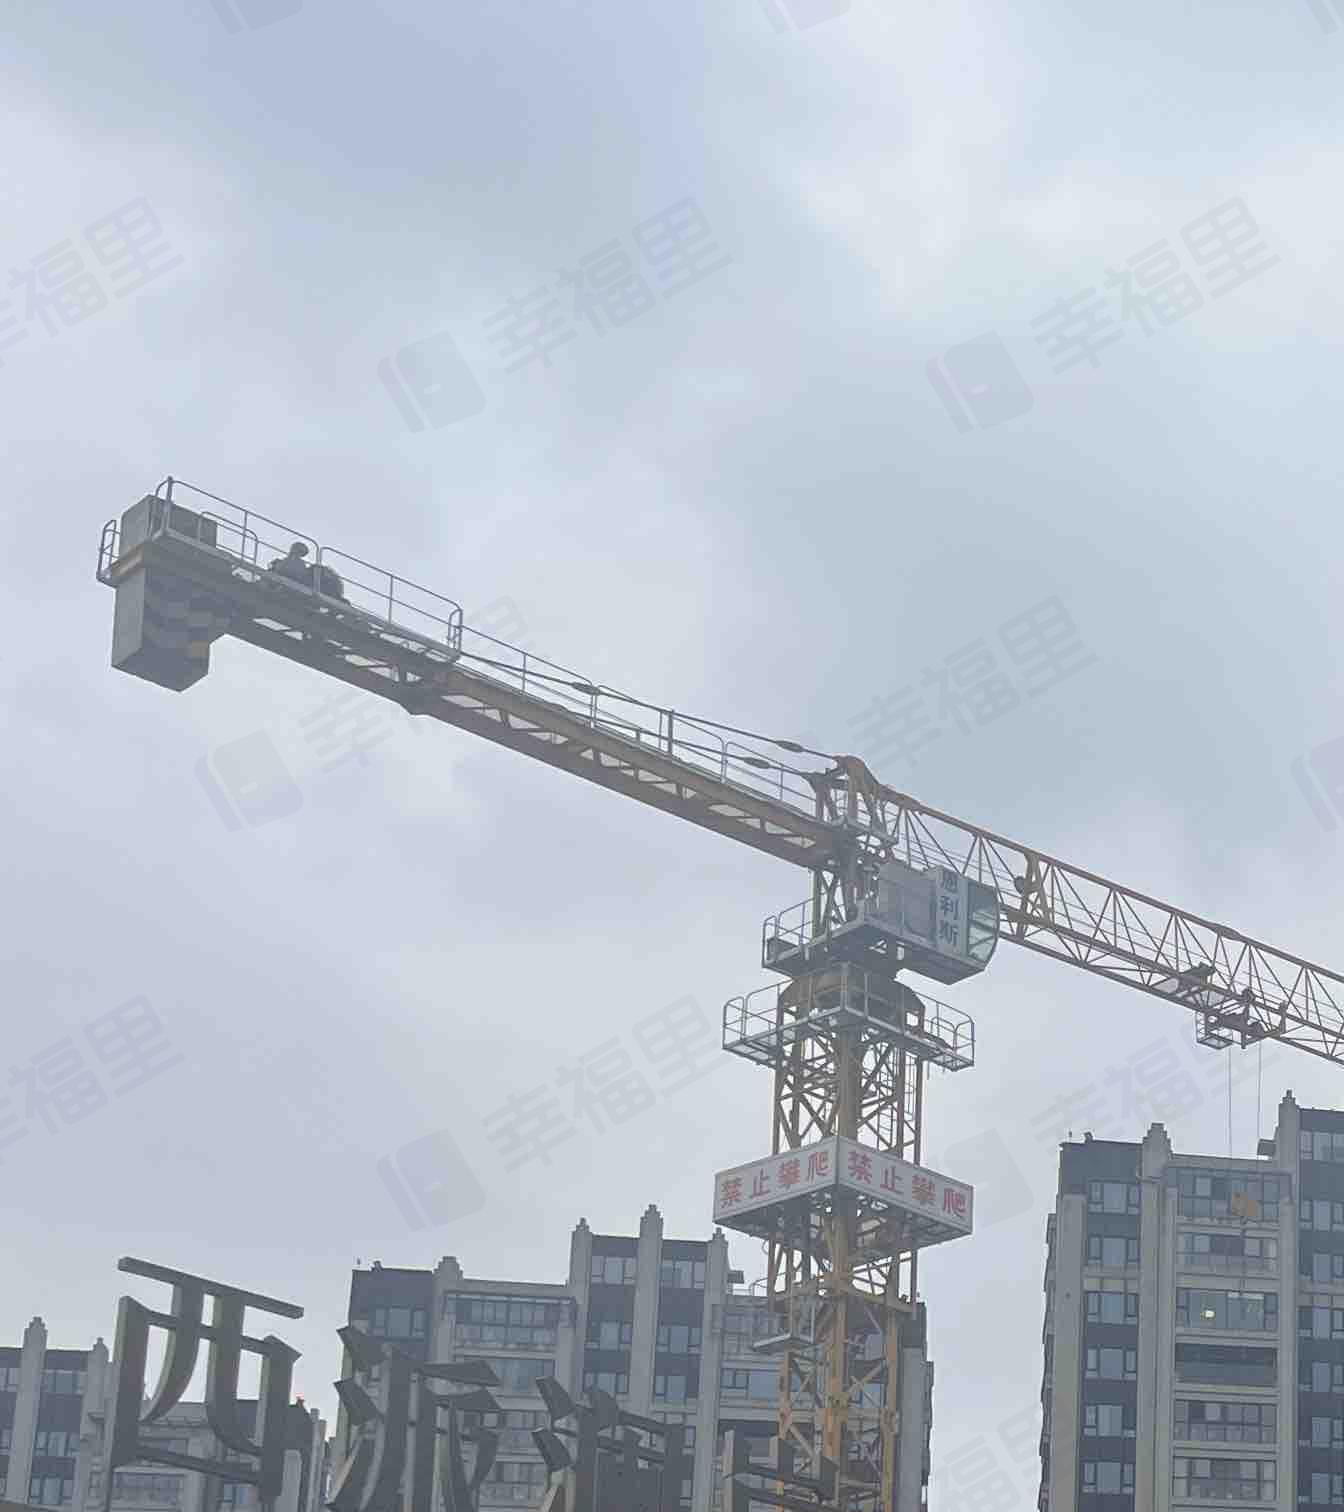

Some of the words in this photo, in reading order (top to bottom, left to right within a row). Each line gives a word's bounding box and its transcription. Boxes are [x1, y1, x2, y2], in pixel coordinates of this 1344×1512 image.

[721, 1151, 831, 1208] 禁止攀爬
[848, 1150, 967, 1217] 禁止攀爬
